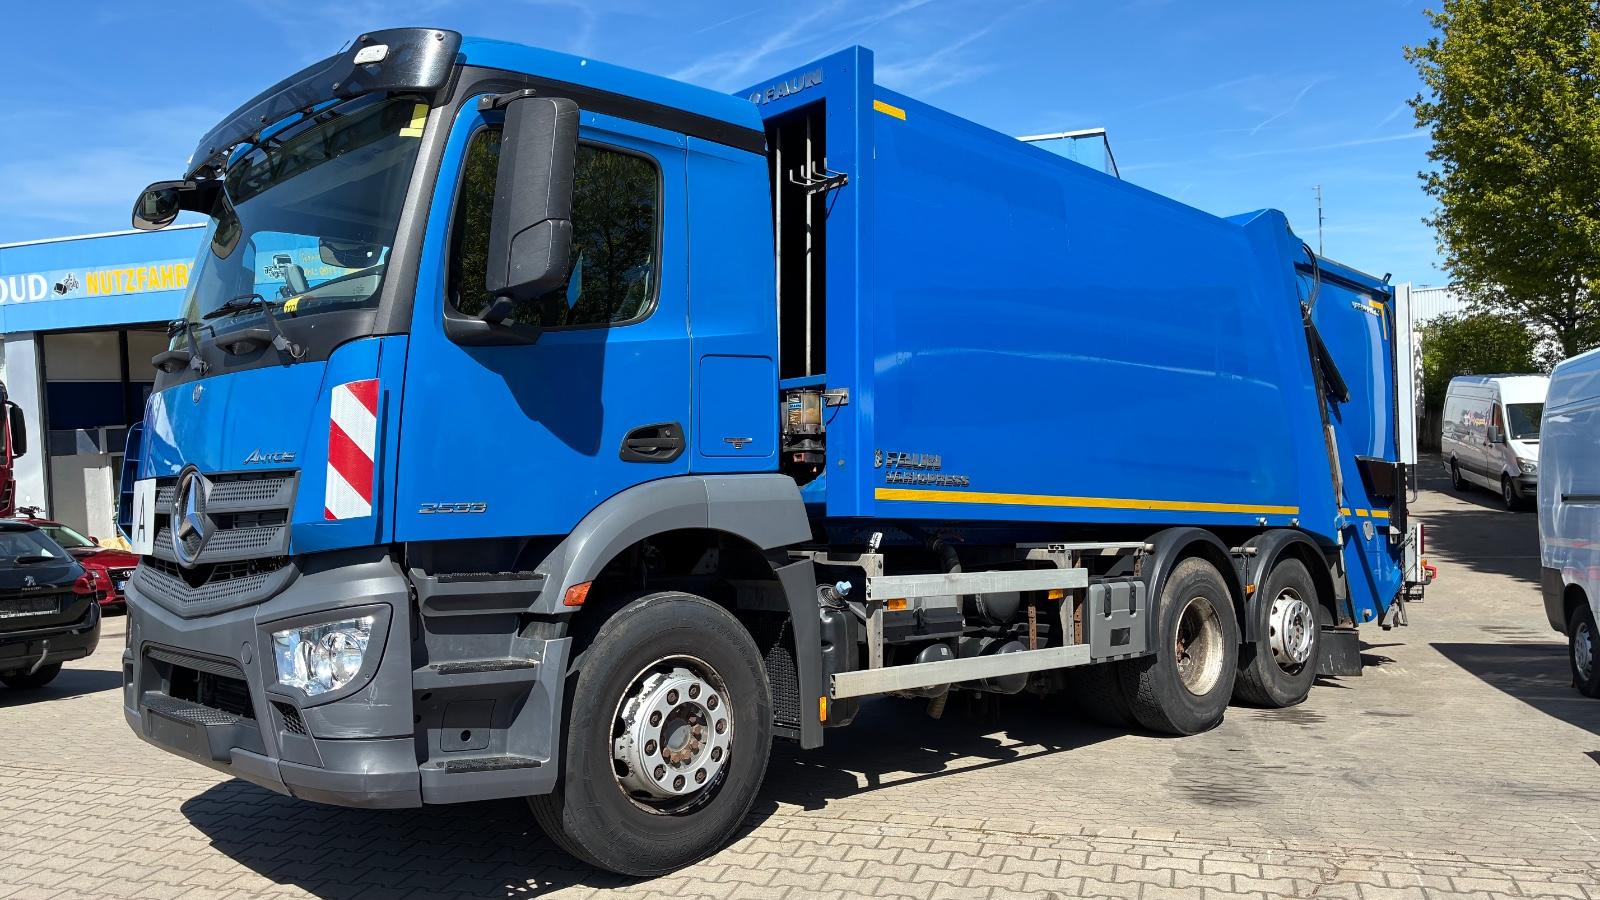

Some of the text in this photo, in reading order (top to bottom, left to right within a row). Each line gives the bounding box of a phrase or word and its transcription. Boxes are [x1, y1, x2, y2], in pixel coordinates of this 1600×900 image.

[763, 66, 824, 106] FAUN
[85, 262, 194, 296] NUTZFAHR
[136, 491, 147, 543] A
